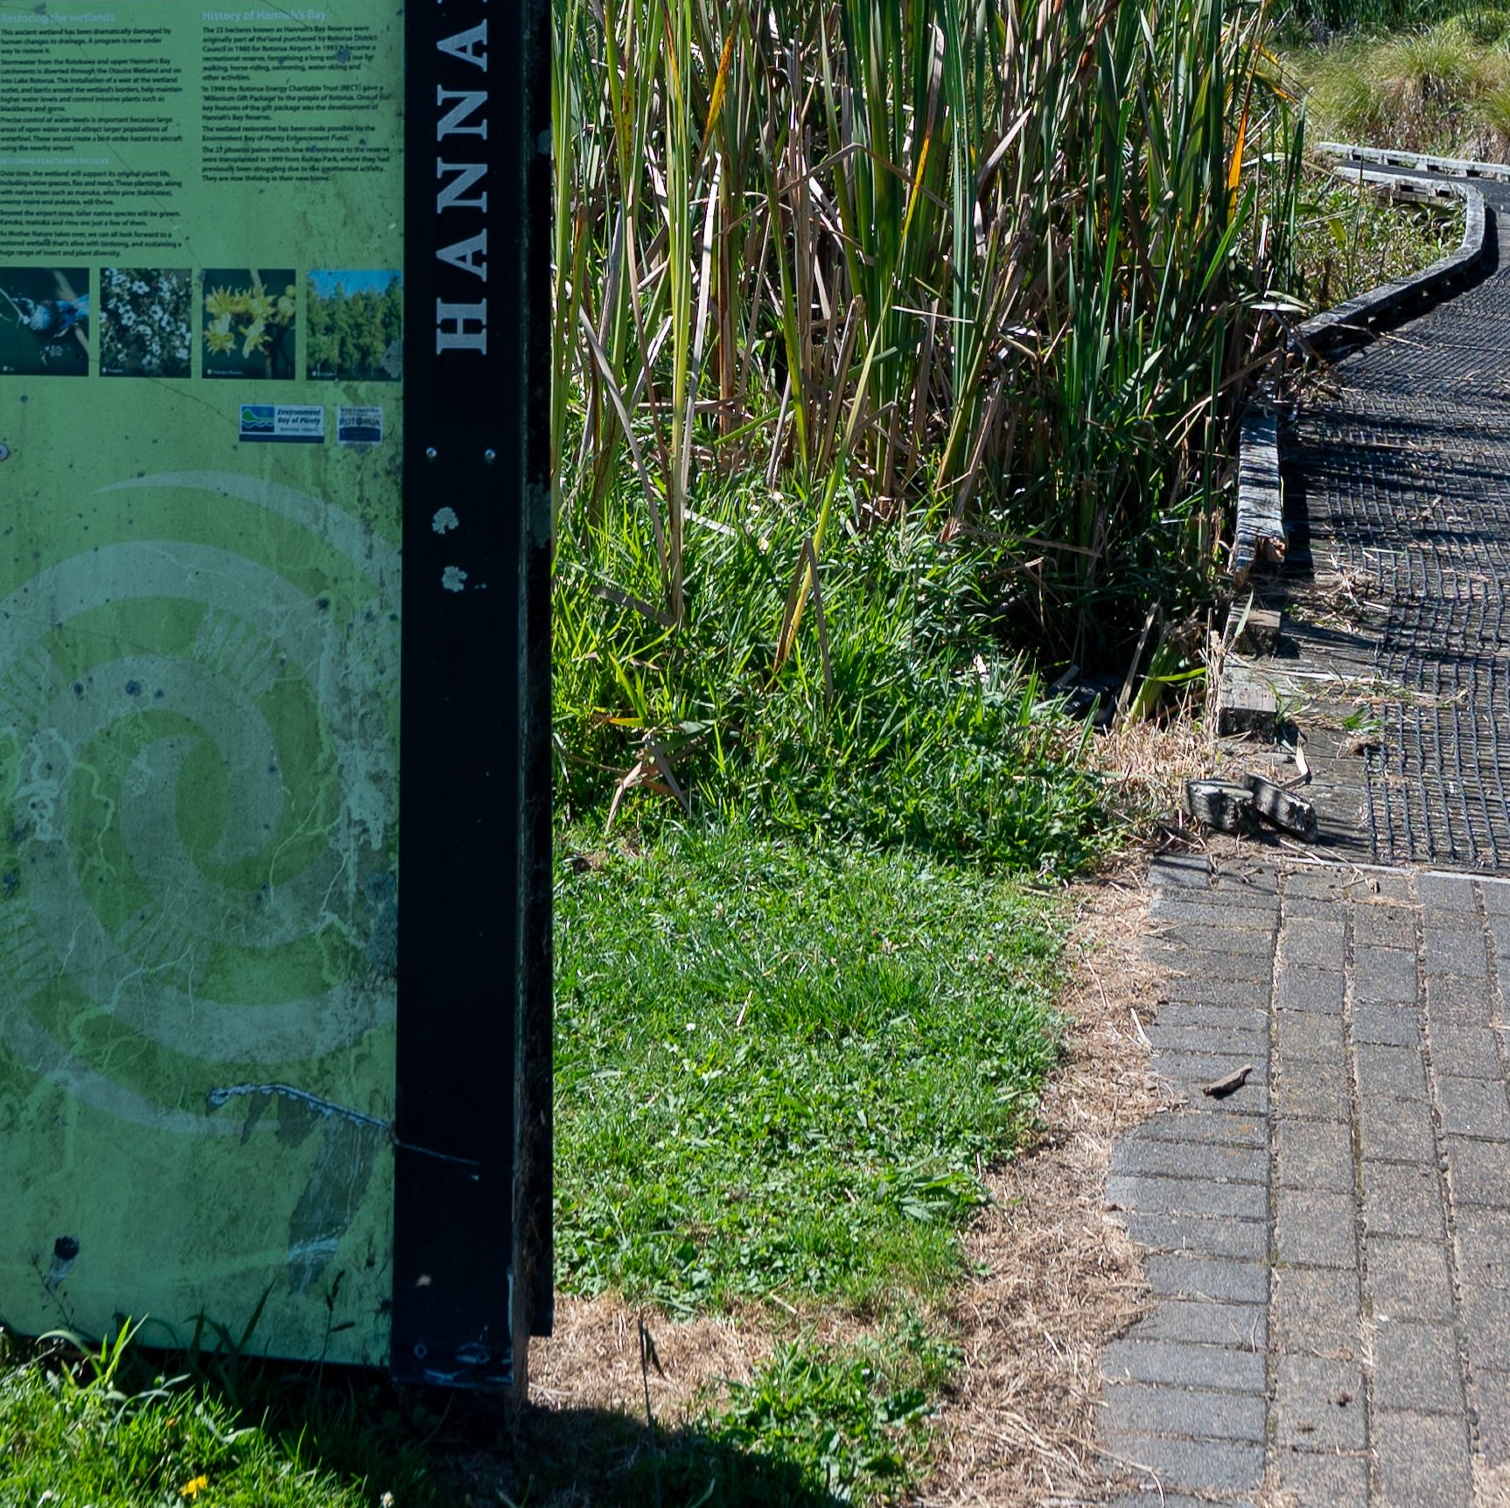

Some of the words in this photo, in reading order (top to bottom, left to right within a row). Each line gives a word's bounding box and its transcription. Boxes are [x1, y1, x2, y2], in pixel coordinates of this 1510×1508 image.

[202, 10, 241, 22] History
[242, 10, 254, 19] of
[256, 9, 305, 19] Hannah's
[306, 9, 328, 21] Bay
[277, 408, 321, 416] Environment
[277, 417, 290, 425] Bay
[300, 417, 321, 426] Plenty
